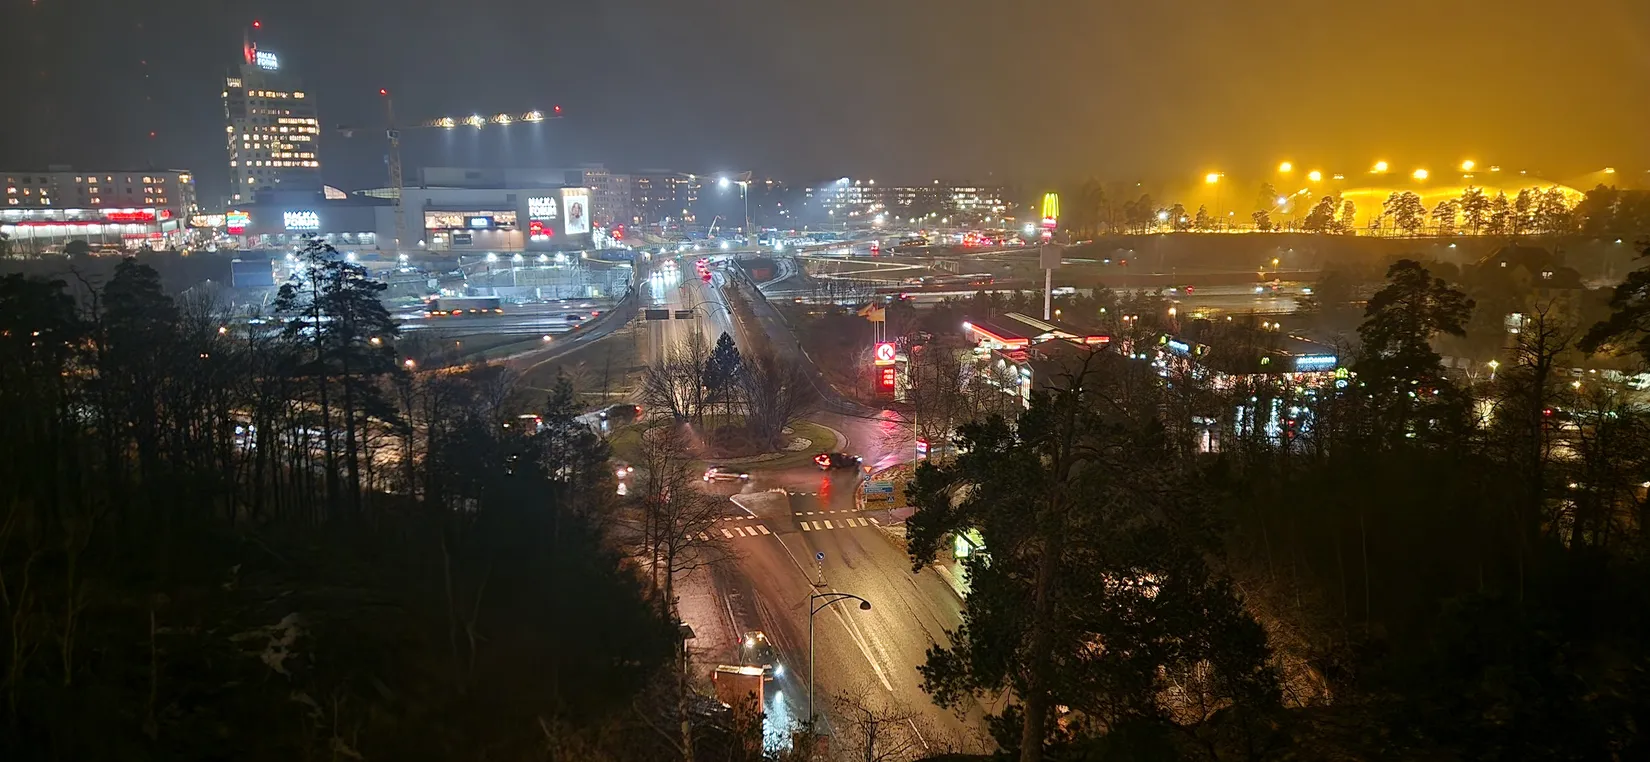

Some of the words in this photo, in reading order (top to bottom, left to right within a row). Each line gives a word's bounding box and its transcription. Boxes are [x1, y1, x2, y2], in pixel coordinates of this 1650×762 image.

[528, 197, 556, 206] NACKA
[284, 211, 319, 219] NACKA
[285, 218, 320, 226] FORUM
